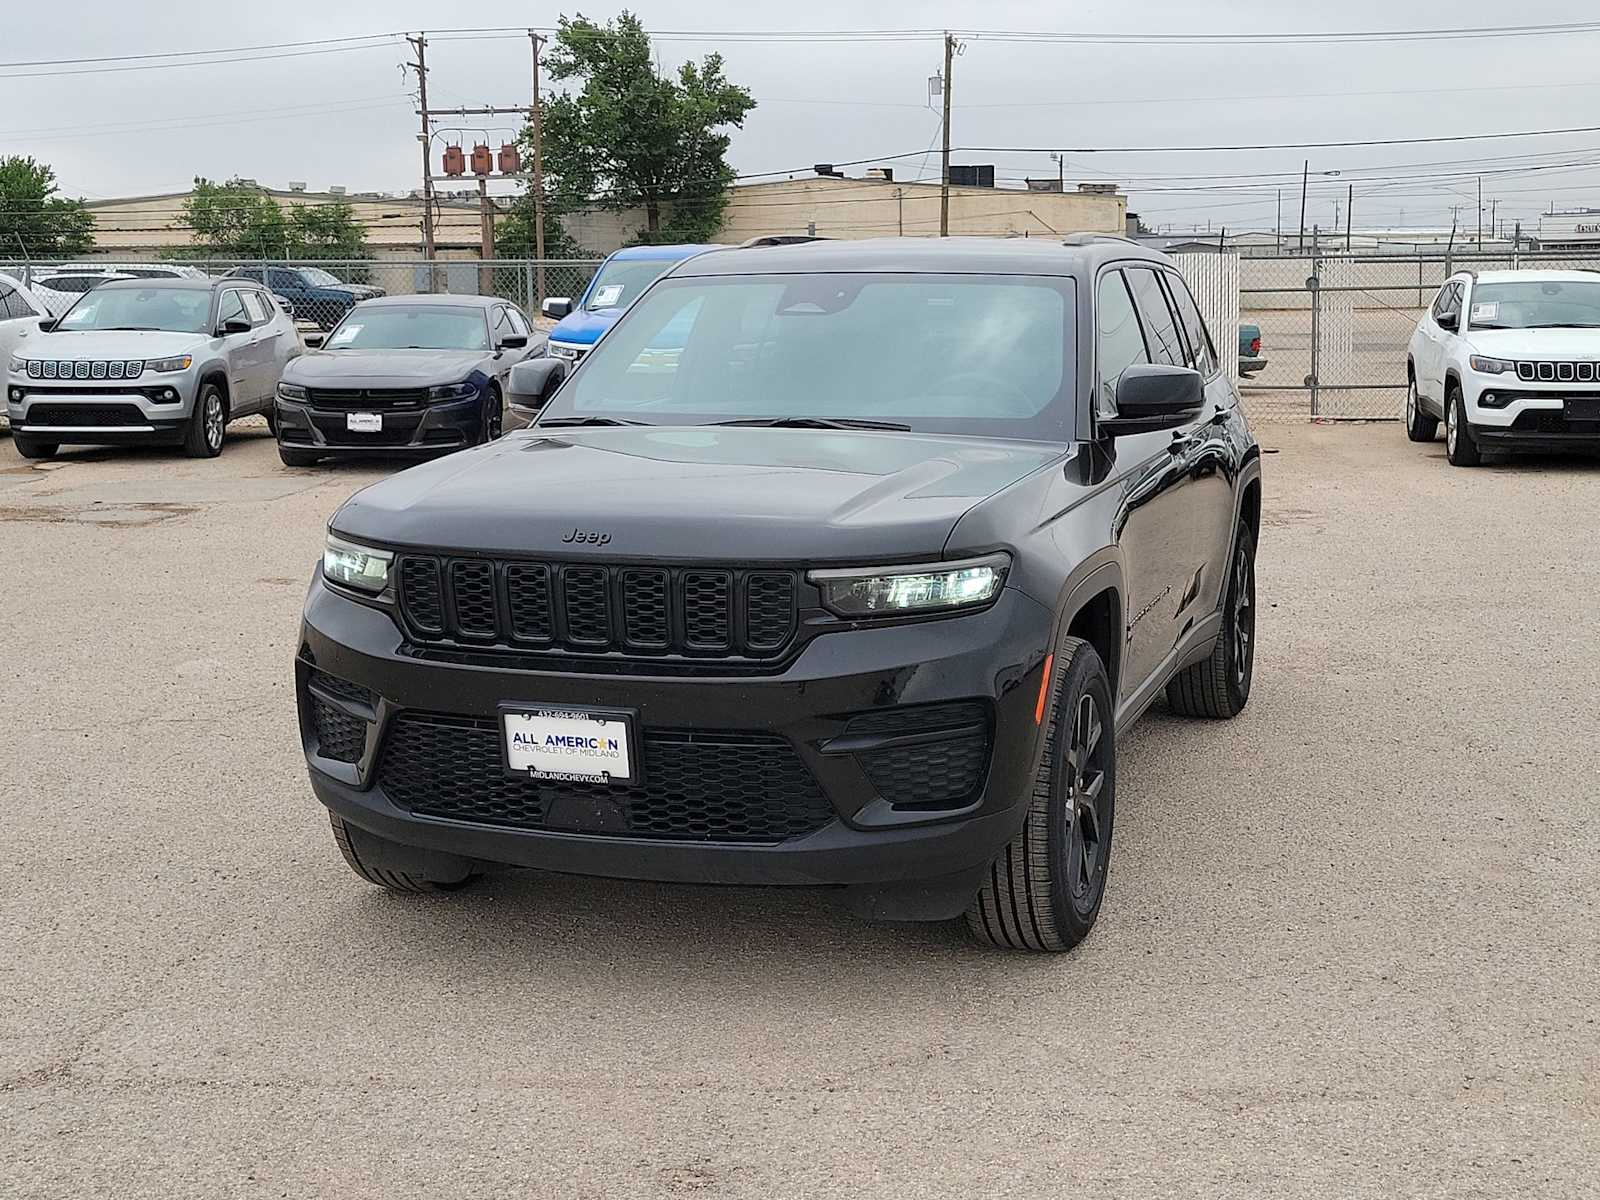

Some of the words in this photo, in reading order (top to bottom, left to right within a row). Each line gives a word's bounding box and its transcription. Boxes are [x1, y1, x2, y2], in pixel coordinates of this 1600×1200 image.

[561, 528, 612, 547] Jeep
[513, 732, 538, 745] ALL
[513, 743, 562, 754] CHEVROLET
[580, 749, 619, 758] MIDLAND
[530, 770, 608, 784] MIDLANDCHEVY.COM
